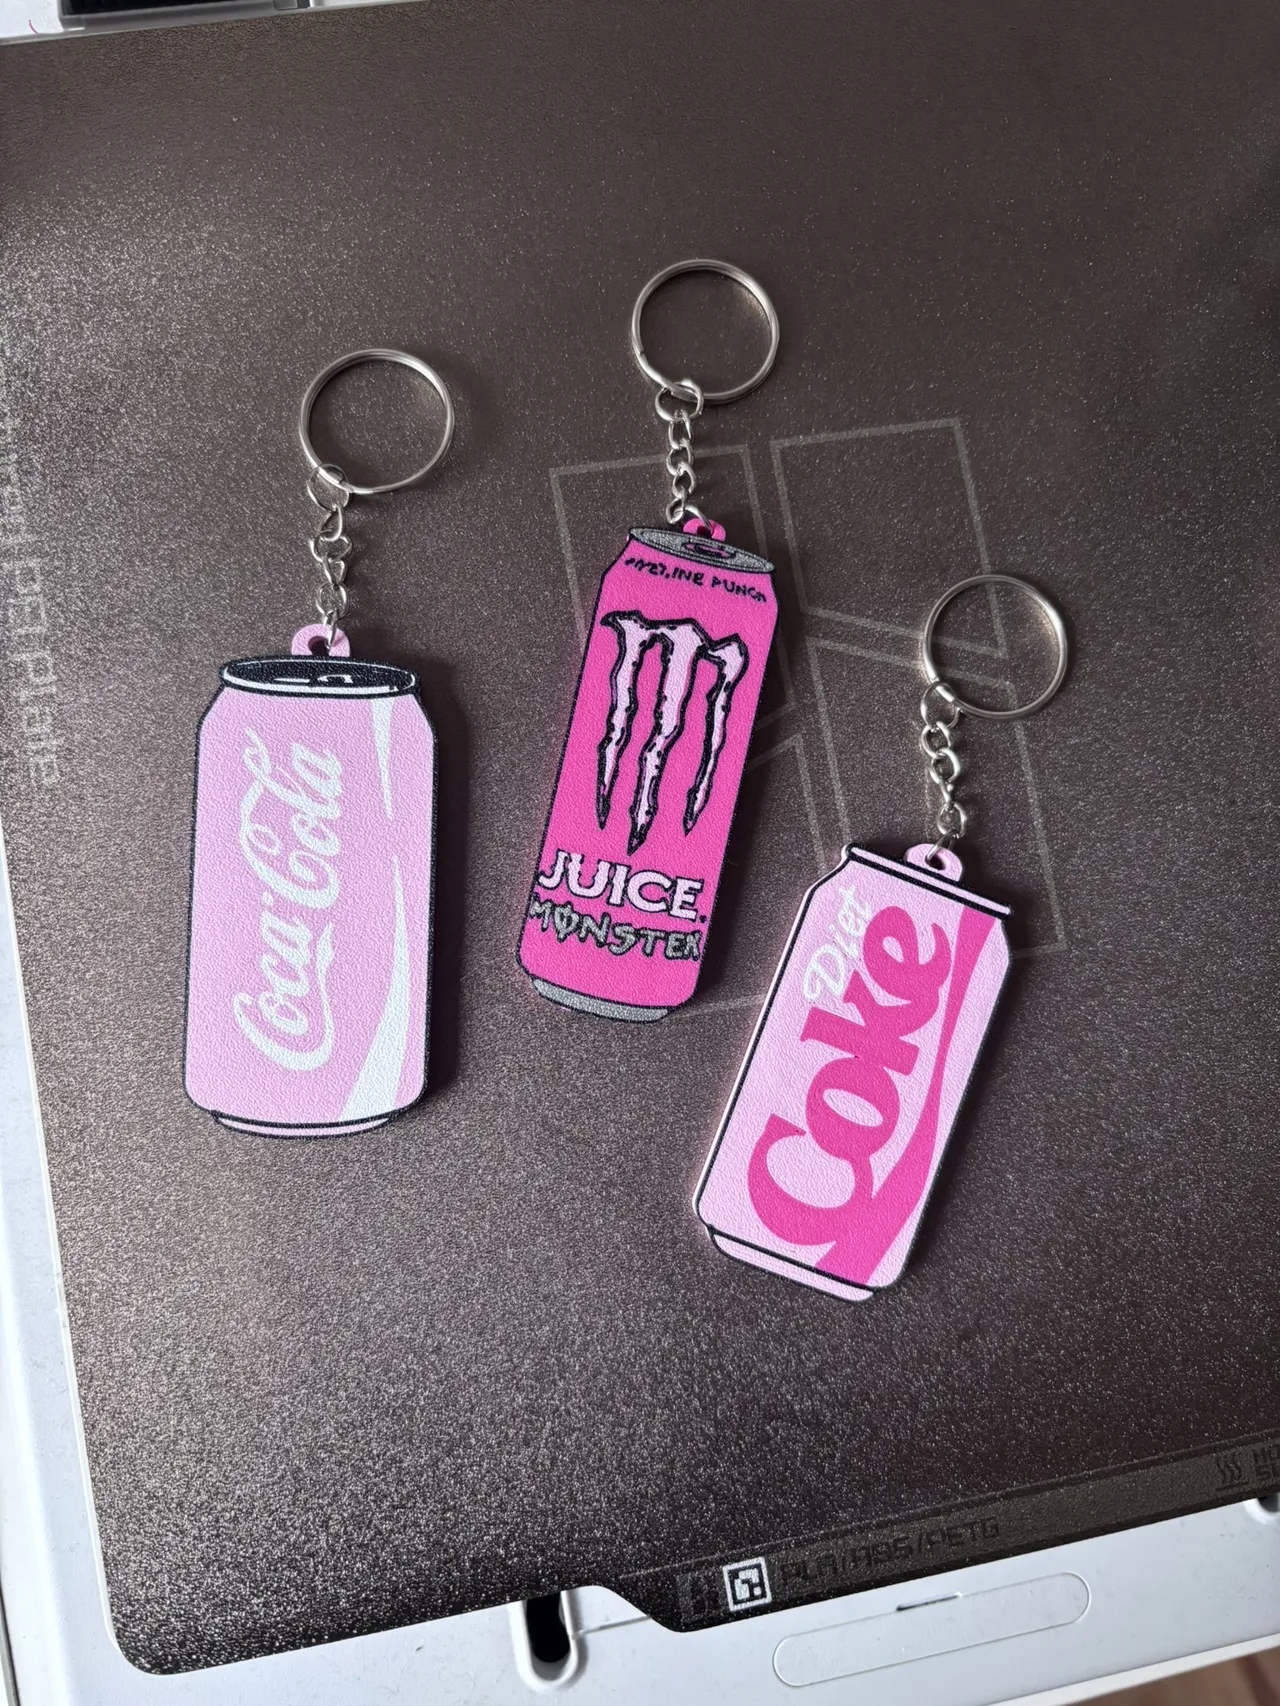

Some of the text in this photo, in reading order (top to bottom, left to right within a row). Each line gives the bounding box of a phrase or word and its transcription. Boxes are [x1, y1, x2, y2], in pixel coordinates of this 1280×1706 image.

[12, 648, 63, 786] Plate
[803, 884, 872, 1001] Diet
[747, 905, 952, 1246] Coke
